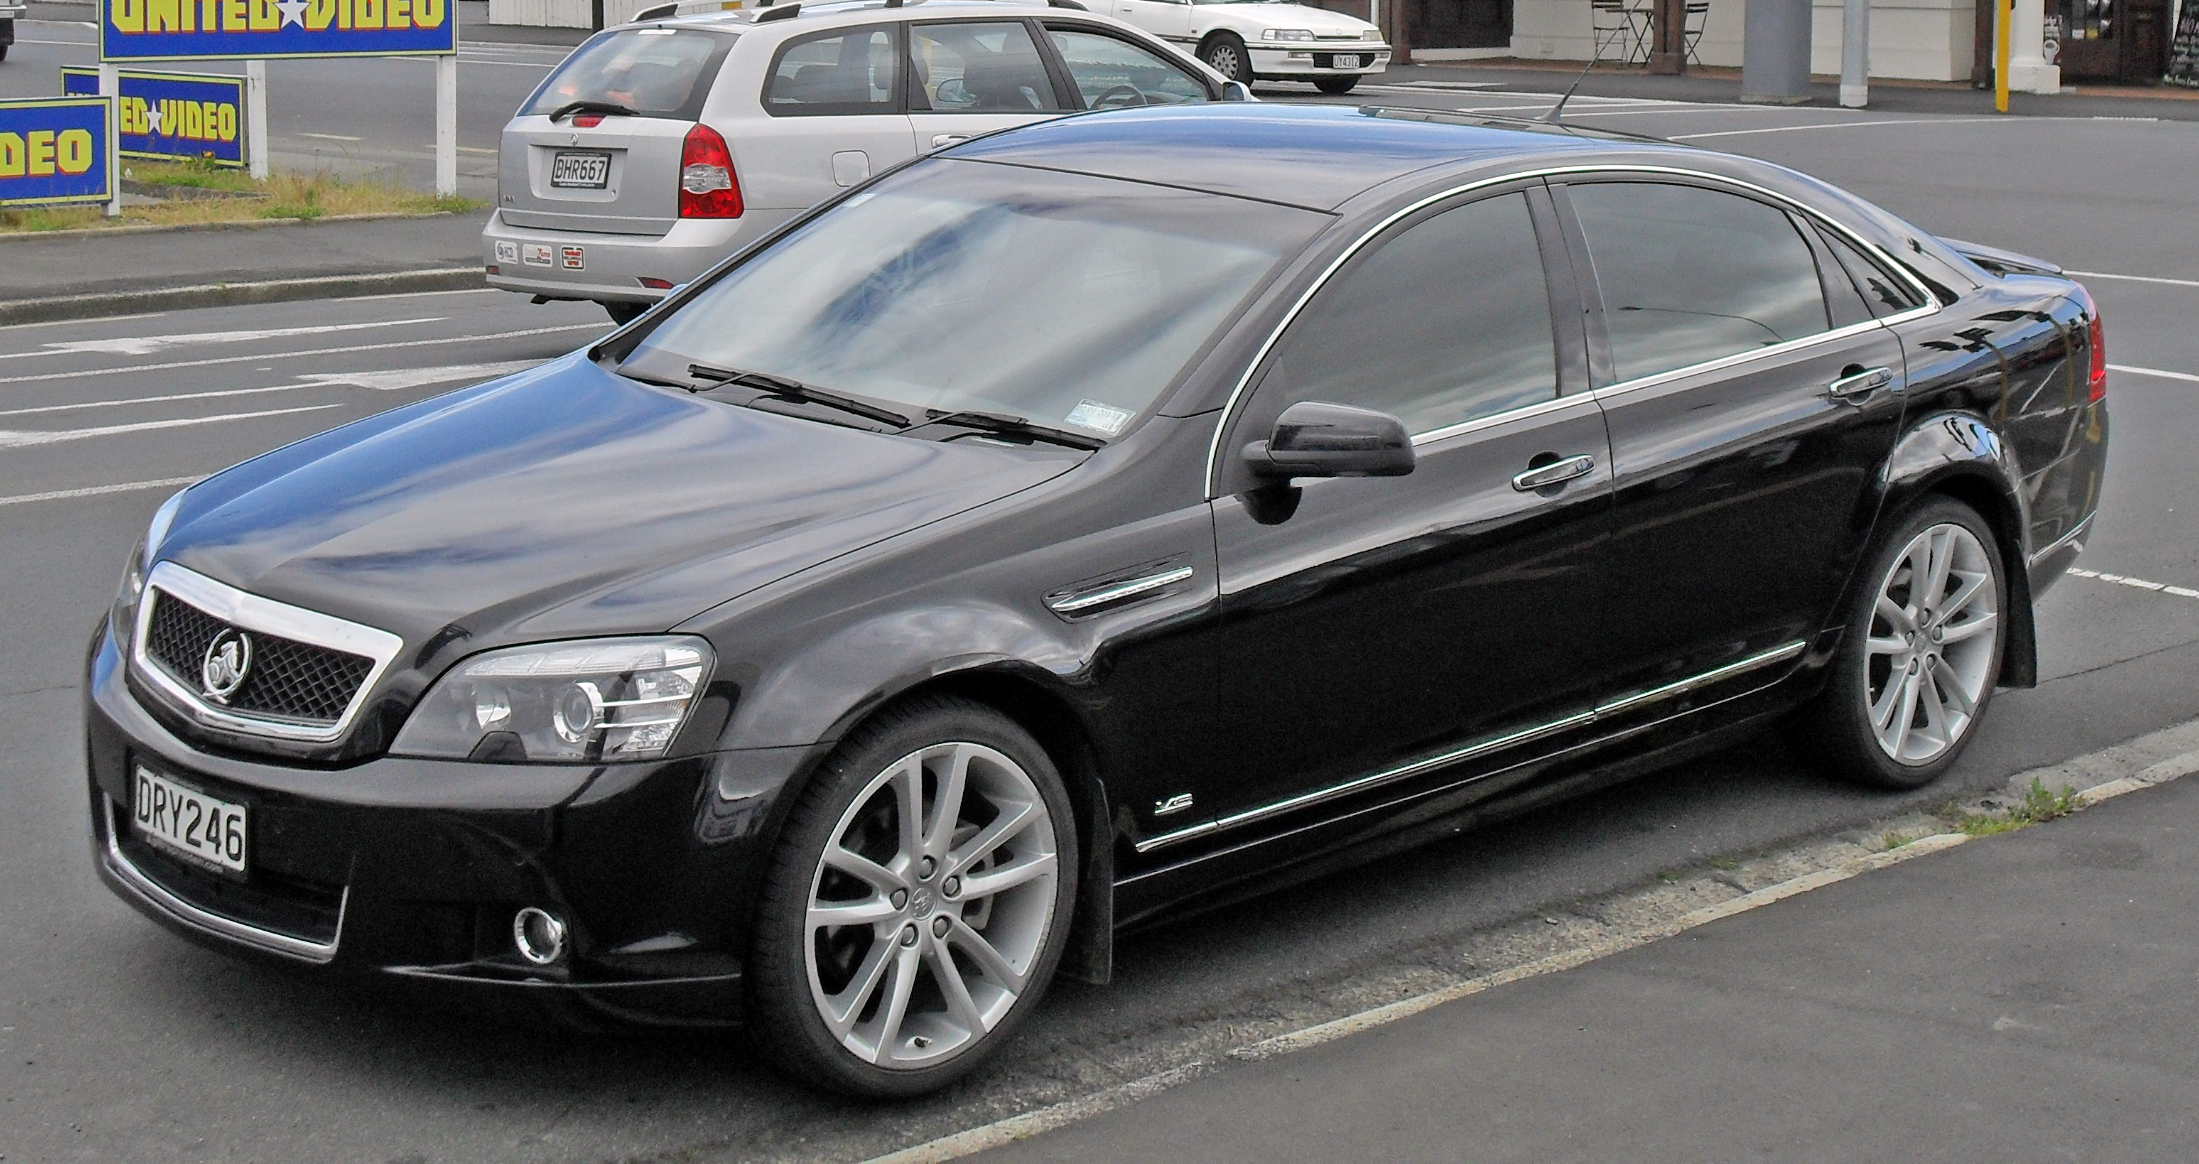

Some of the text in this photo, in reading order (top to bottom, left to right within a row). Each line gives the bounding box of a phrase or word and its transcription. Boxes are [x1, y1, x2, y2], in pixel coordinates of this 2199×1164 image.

[303, 0, 445, 29] VIDEO
[160, 98, 236, 142] VIDEO
[138, 775, 243, 862] DRY246
